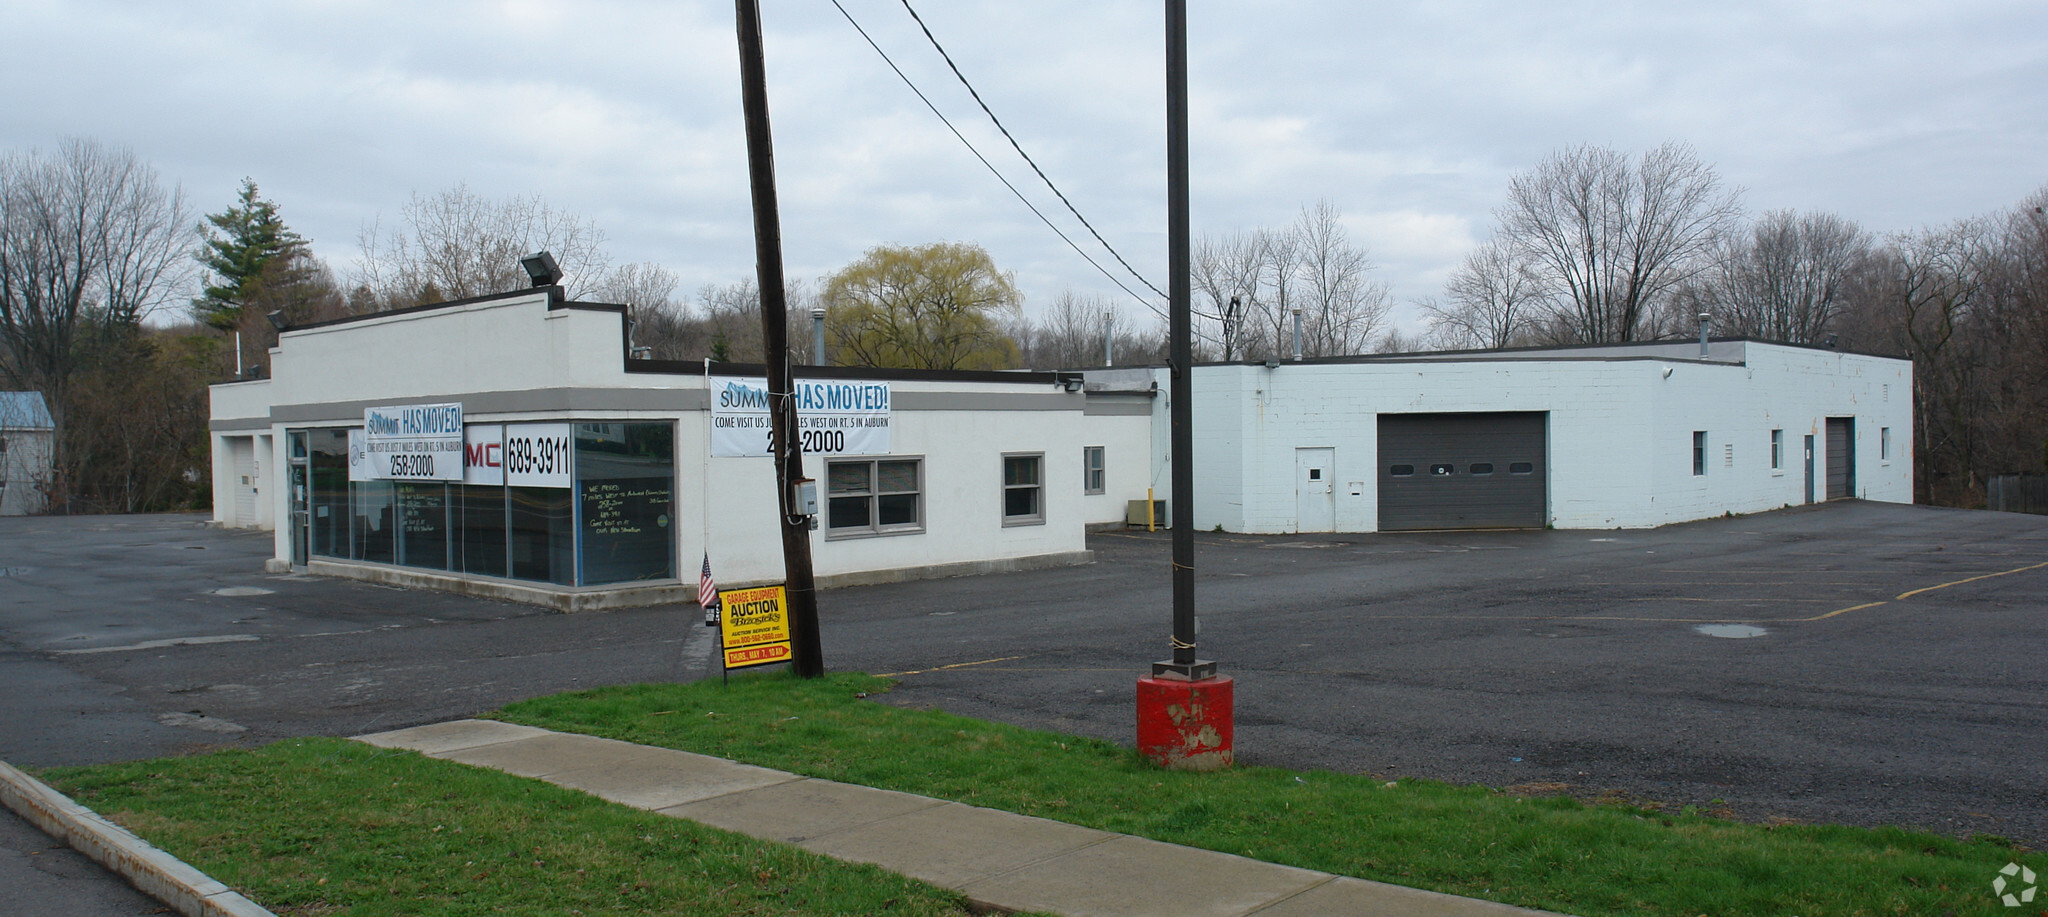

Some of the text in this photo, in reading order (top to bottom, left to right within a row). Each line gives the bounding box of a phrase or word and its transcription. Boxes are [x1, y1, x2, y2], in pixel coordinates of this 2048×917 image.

[827, 385, 888, 410] MOVED!
[368, 407, 461, 435] SUMMIT HAS MOVED!
[715, 416, 734, 428] COME
[736, 416, 753, 428] VISIT
[755, 416, 764, 428] US
[810, 417, 827, 428] WEST
[828, 417, 838, 428] ON
[840, 417, 849, 428] RT.
[850, 417, 855, 428] 5
[856, 417, 863, 428] IN
[864, 417, 889, 428] AUBURN
[446, 441, 462, 452] AUBURN
[466, 442, 502, 468] MC
[508, 436, 569, 475] 689-3911
[391, 454, 434, 477] 258-2000
[727, 588, 779, 605] GARAGE EQUIPMENT
[731, 599, 779, 618] AUCTION
[749, 649, 760, 660] MAY
